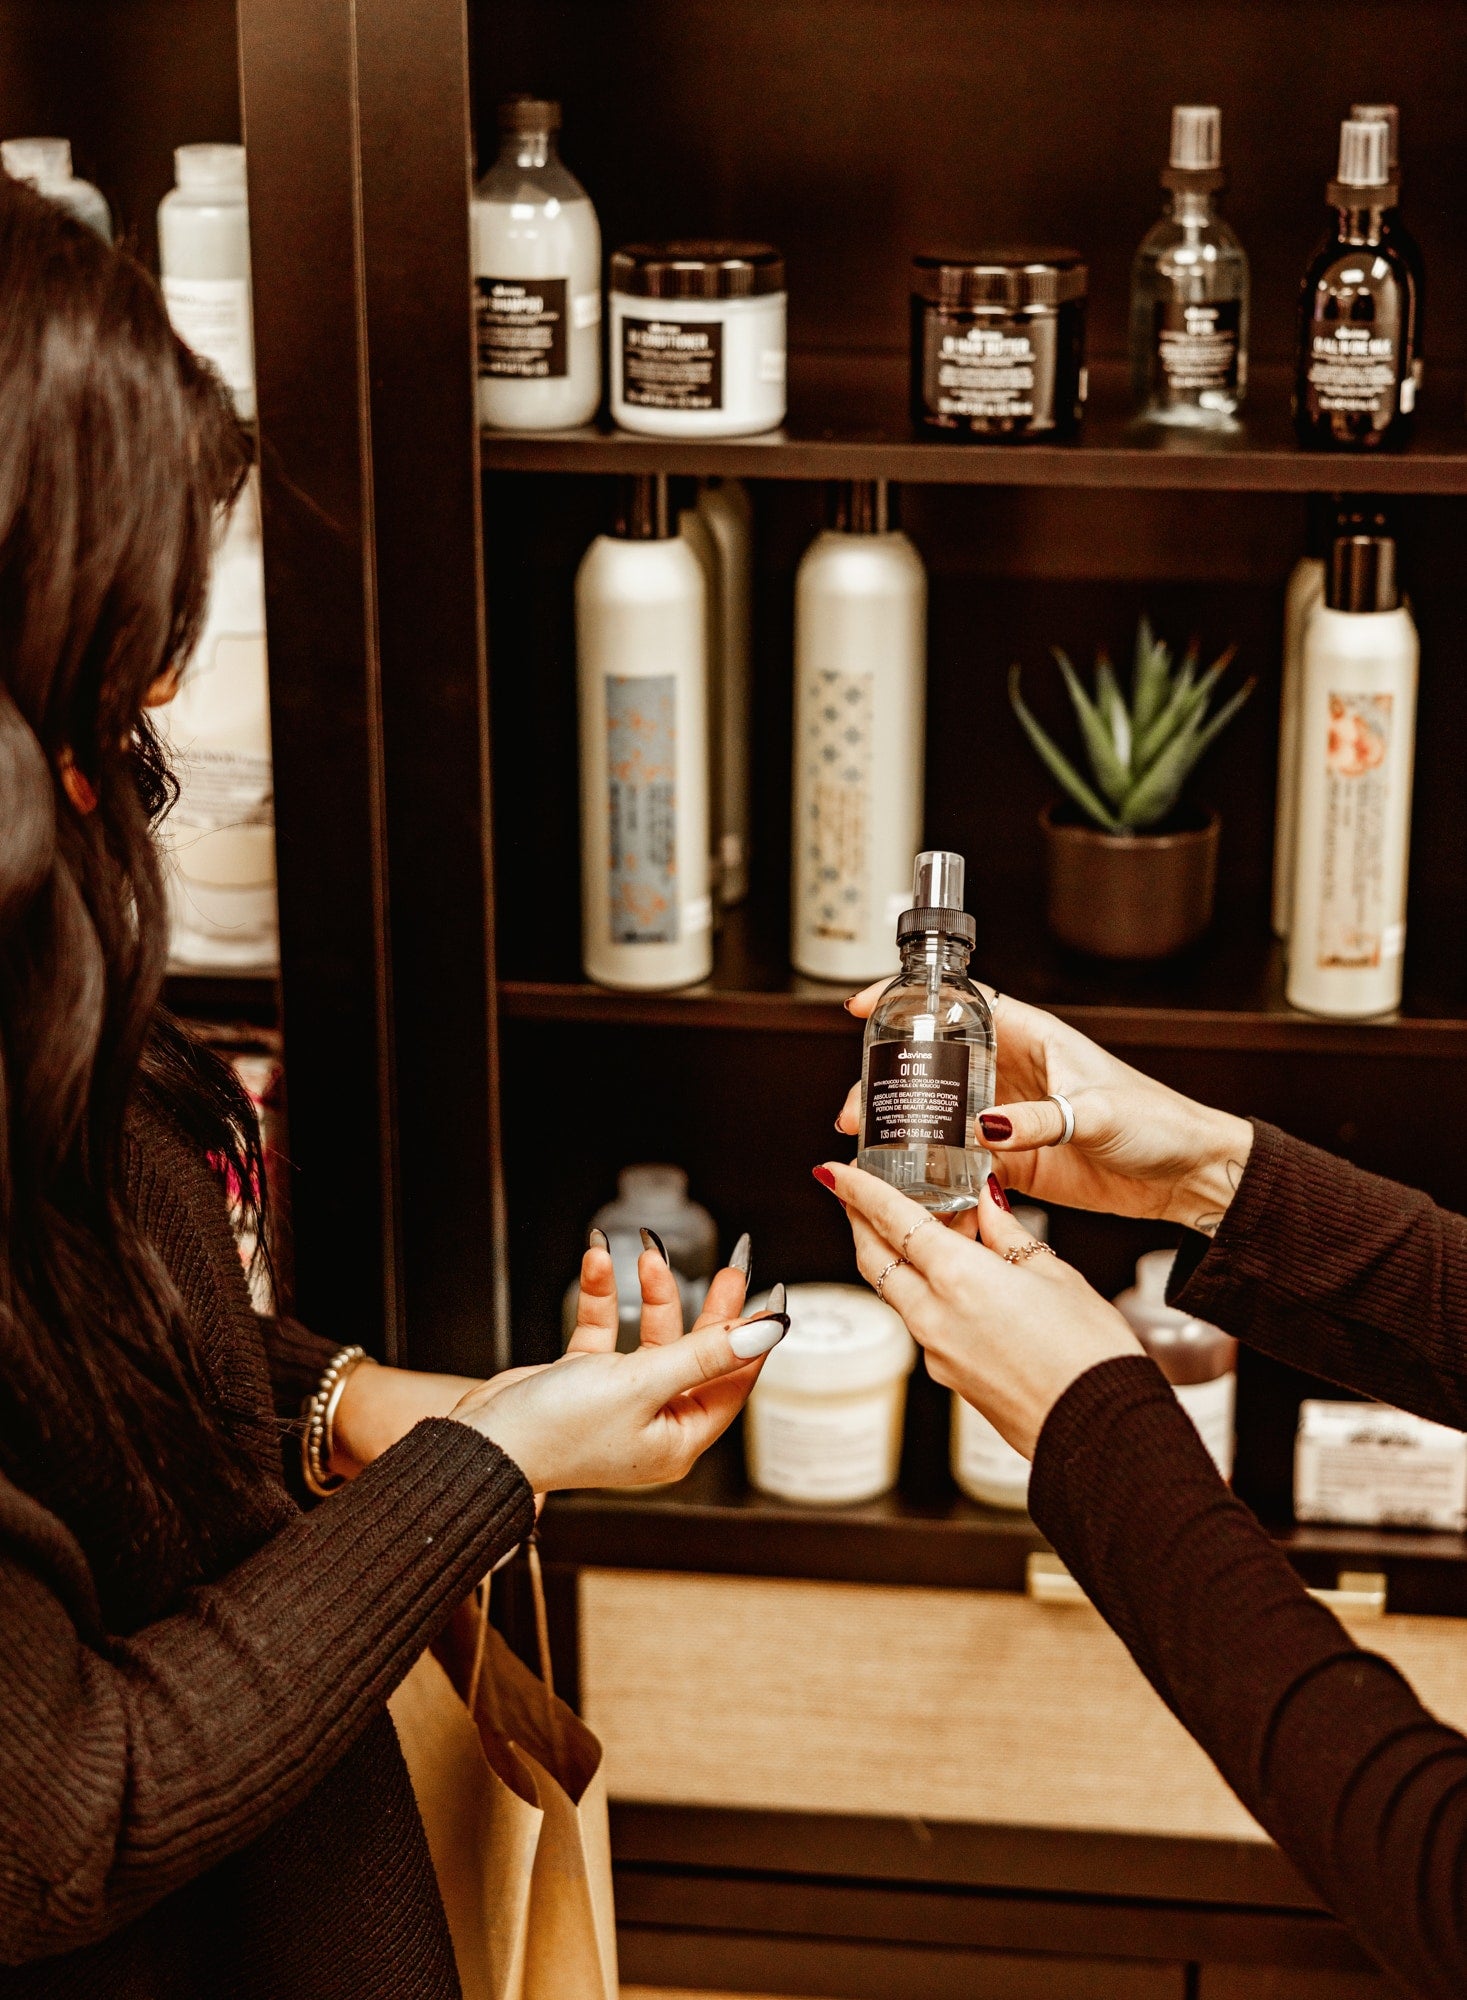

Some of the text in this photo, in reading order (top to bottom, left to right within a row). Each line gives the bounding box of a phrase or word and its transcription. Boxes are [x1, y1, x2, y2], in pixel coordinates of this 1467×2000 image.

[898, 1048, 933, 1060] davines
[900, 1063, 928, 1077] OI OIL
[873, 1091, 958, 1101] ABSOLUTE BEAUTIFYING POTION
[872, 1098, 893, 1107] POZIONE
[929, 1098, 959, 1107] ASSOLUTA
[875, 1105, 894, 1113] POTION
[925, 1104, 954, 1113] ABSOLUE
[880, 1129, 889, 1140] 135
[890, 1129, 897, 1138] ml
